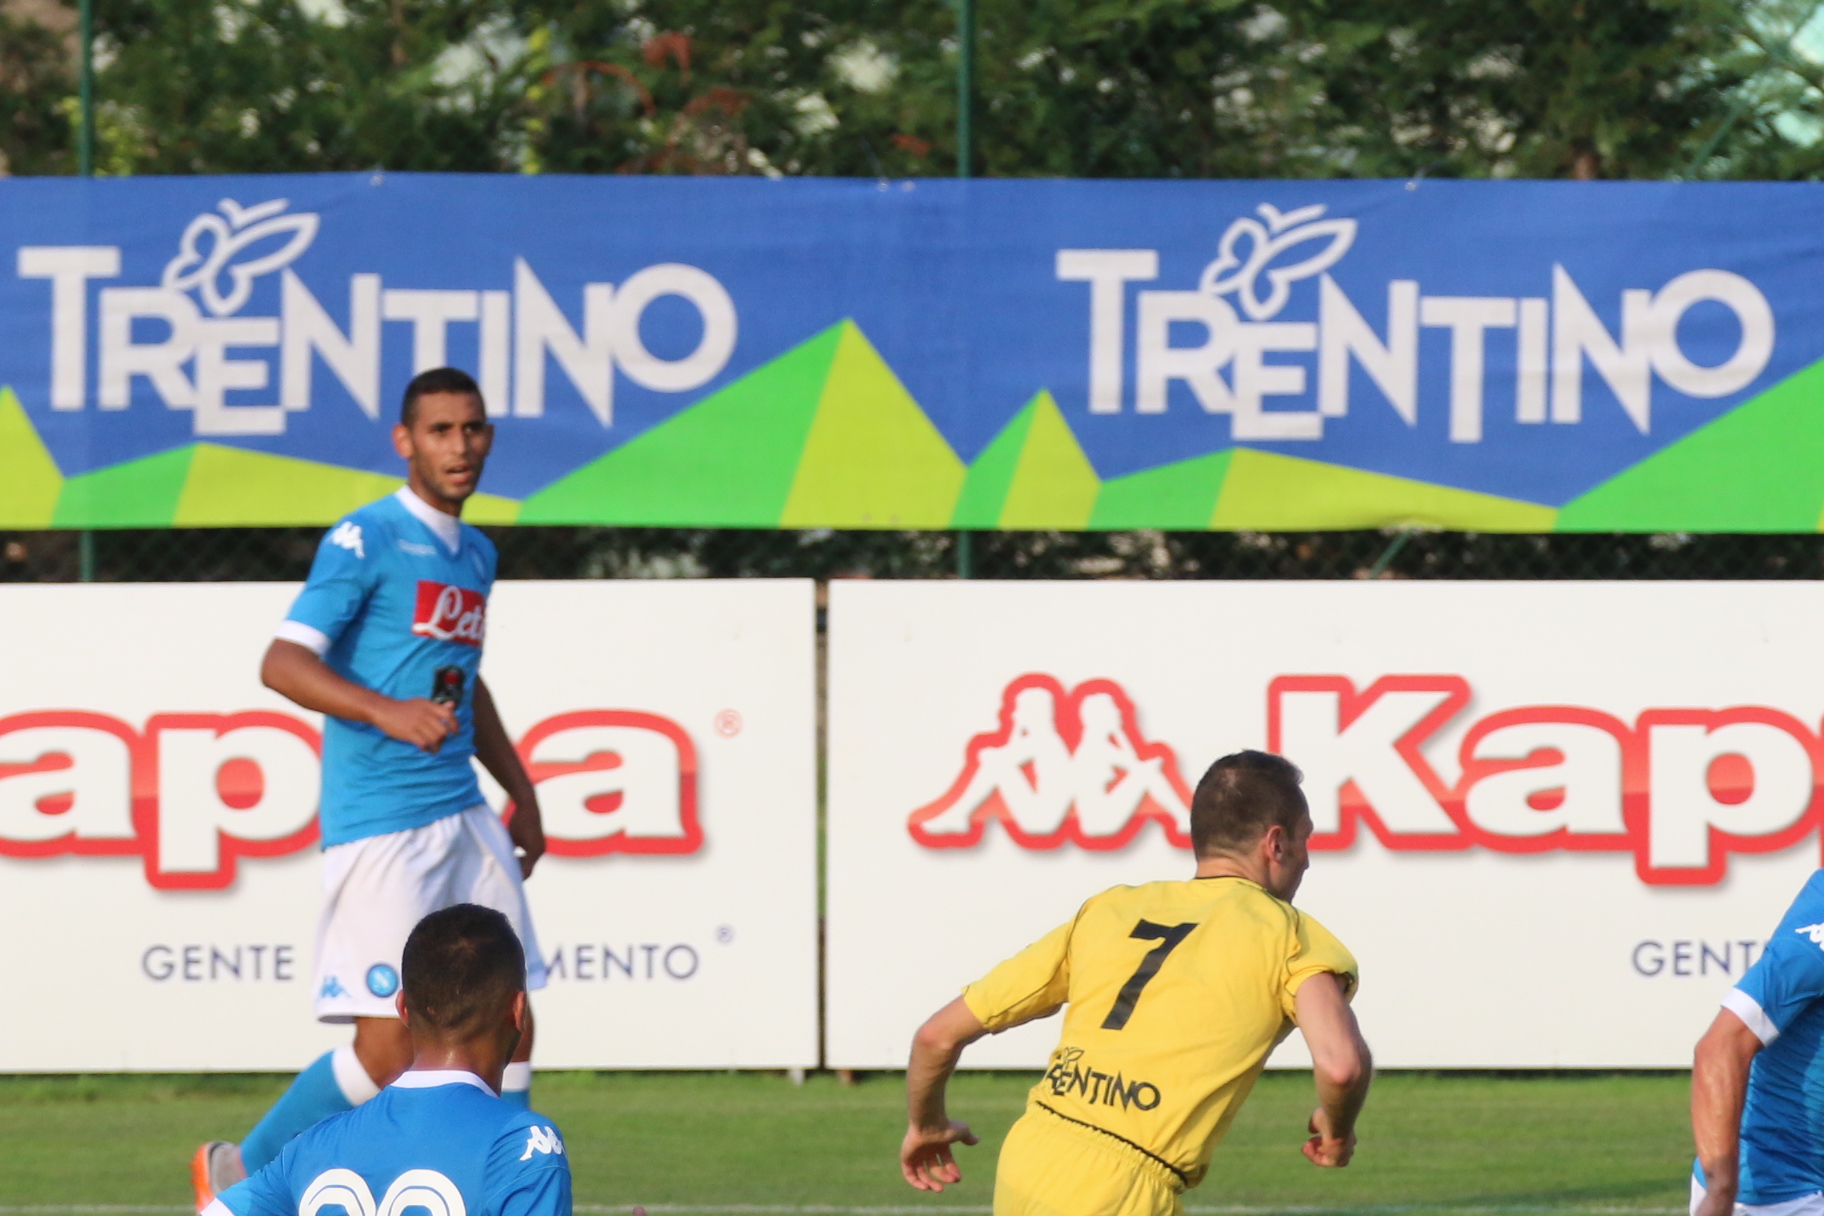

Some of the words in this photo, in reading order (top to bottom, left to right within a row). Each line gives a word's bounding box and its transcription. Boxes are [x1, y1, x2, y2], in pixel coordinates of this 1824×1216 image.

[17, 246, 738, 435] TRENTINO
[1056, 249, 1776, 443] TRENTINO
[0, 708, 705, 891] apa
[142, 945, 294, 982] GENTE
[1100, 918, 1199, 1031] 7
[1632, 939, 1770, 977] GENT
